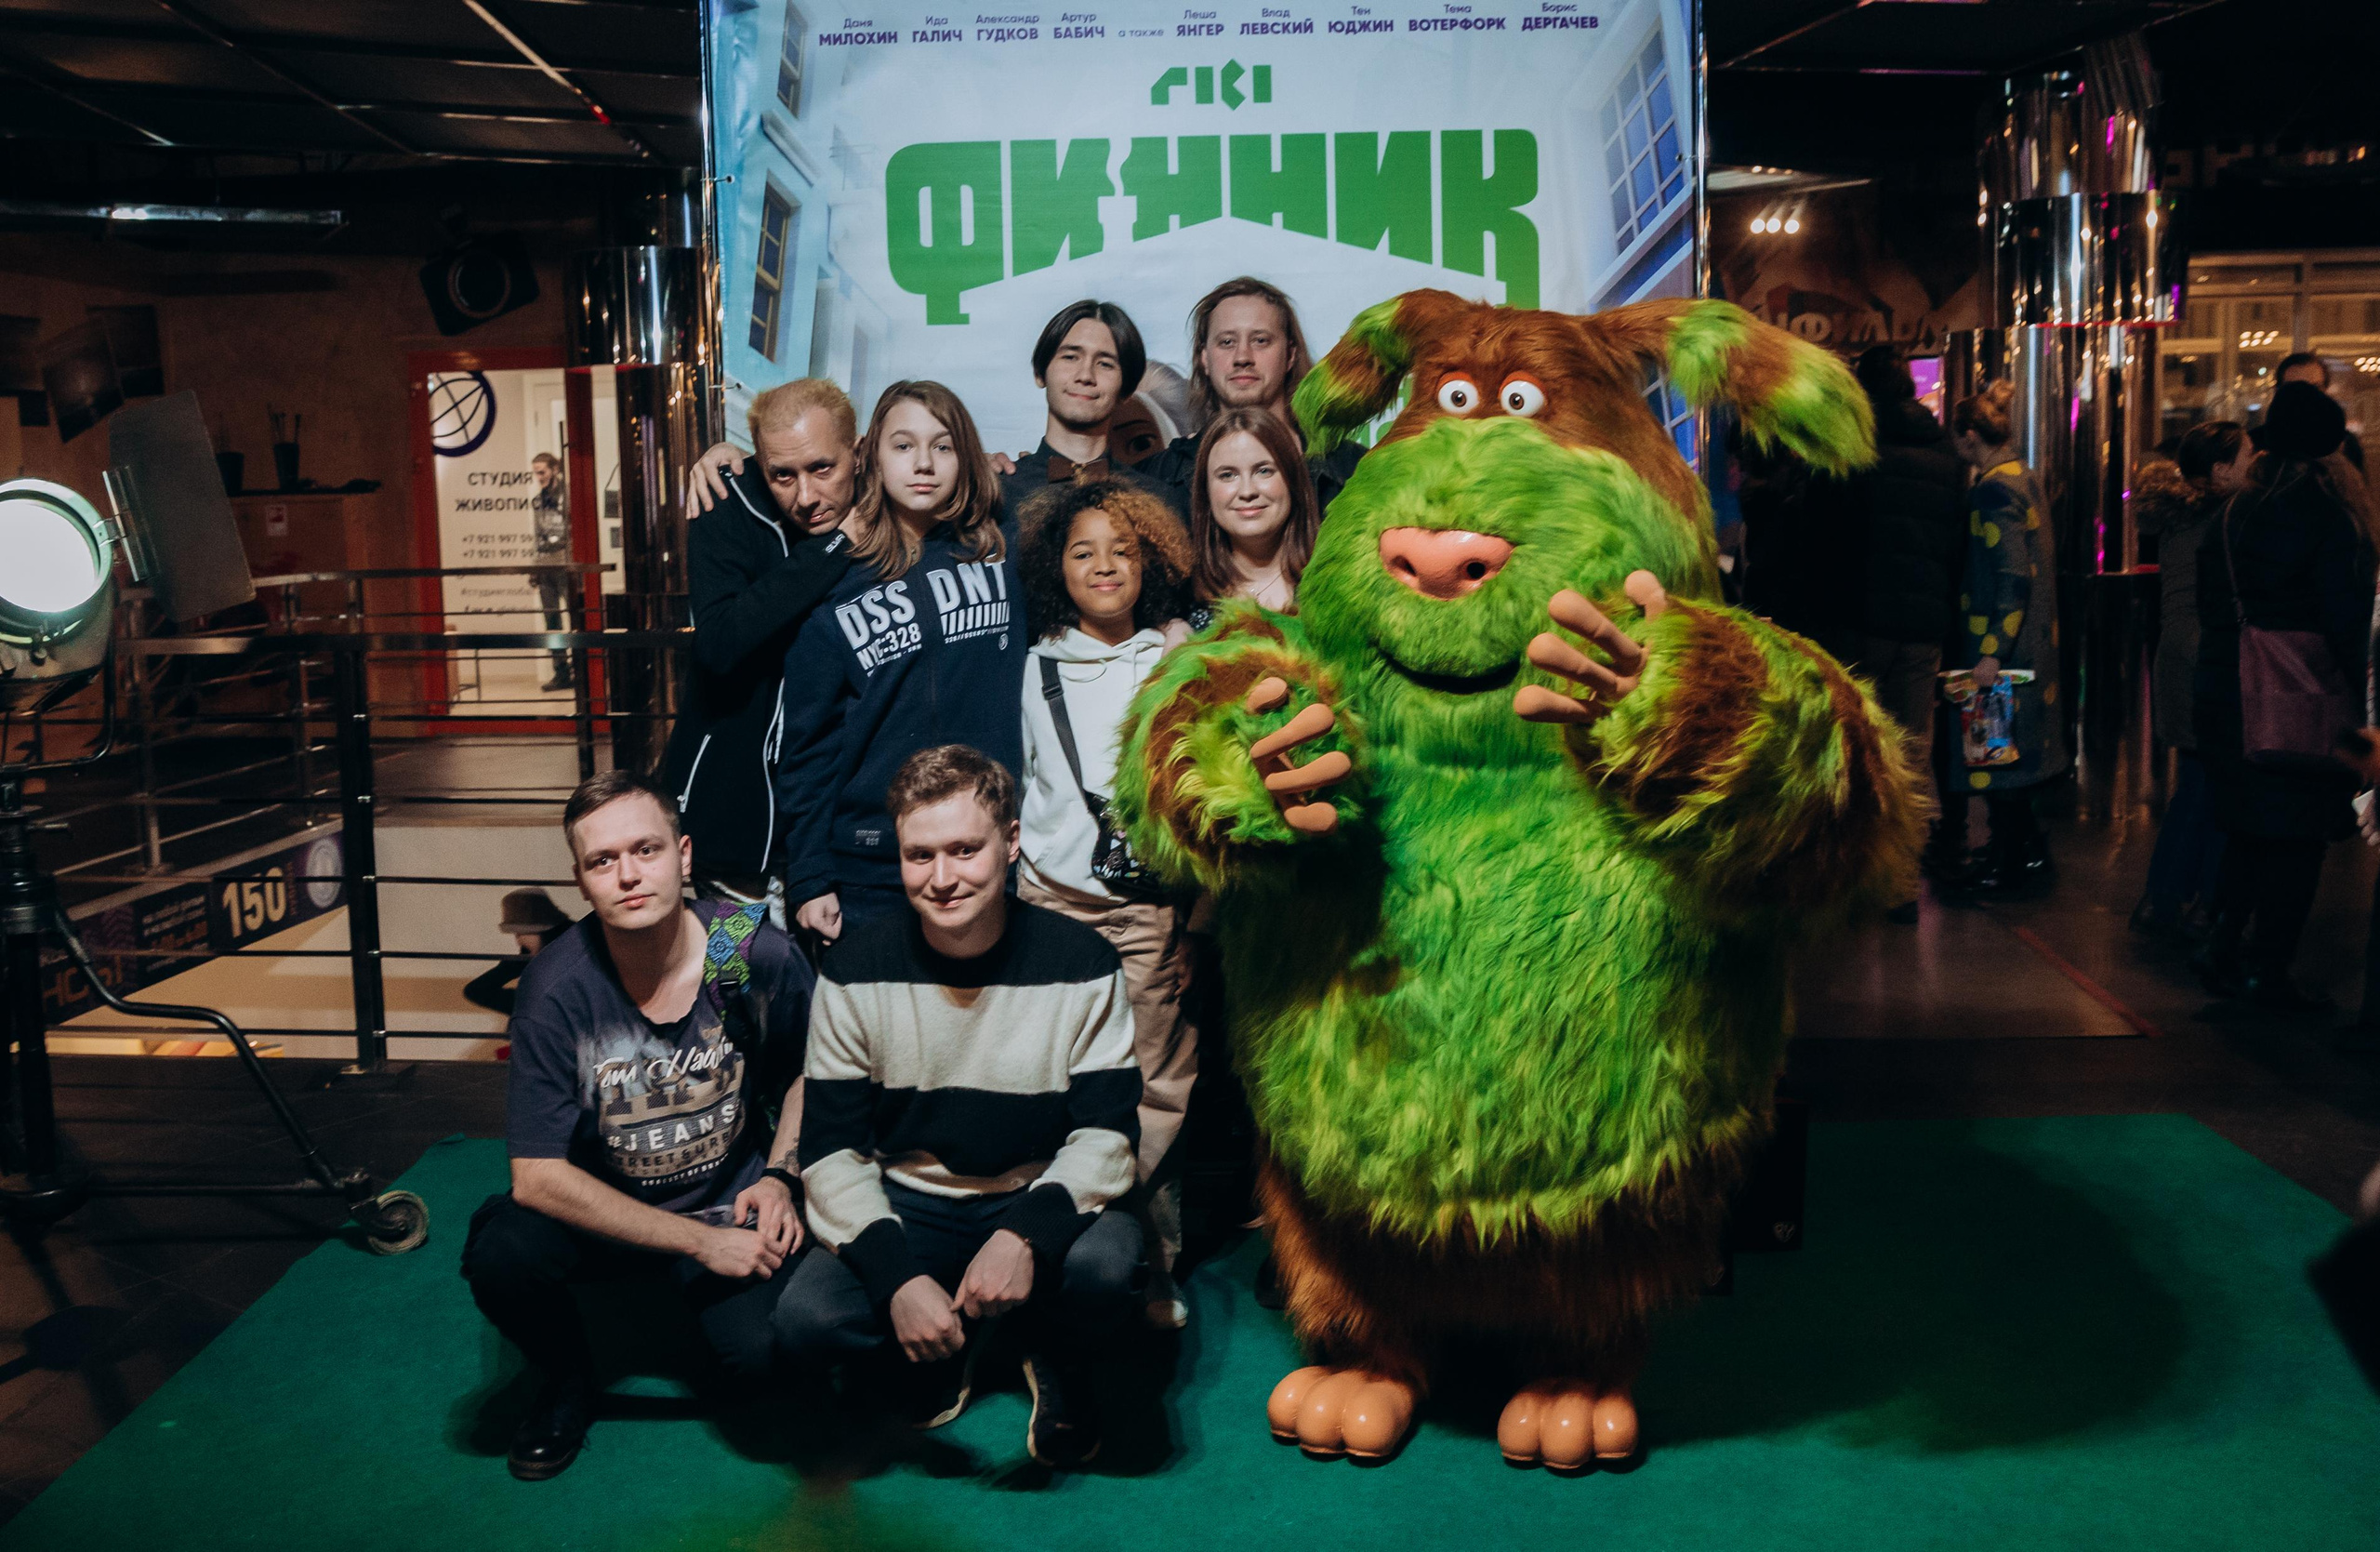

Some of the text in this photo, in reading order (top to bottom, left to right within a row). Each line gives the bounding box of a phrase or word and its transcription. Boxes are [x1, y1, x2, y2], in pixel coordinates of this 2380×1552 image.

[818, 31, 899, 46] МИЛОХИН
[912, 29, 963, 44] ГАЛИЧ
[976, 27, 1039, 43] ГУДКОВ
[1053, 25, 1105, 40] БАБИЧ
[1128, 28, 1164, 38] также
[1176, 23, 1225, 37] ЯНГЕР
[1239, 19, 1315, 36] ЛЕВСКИЙ
[1328, 19, 1395, 34] ЮДЖИН
[1408, 17, 1506, 33] ВОТЕРФОРК
[1521, 15, 1599, 32] ДЕРГАЧЕВ
[844, 19, 873, 30] Даня
[925, 16, 948, 27] Ида
[975, 14, 1040, 25] Александр
[1061, 12, 1097, 24] Артур
[1262, 8, 1290, 19] Влад
[1351, 6, 1371, 16] Тен
[1444, 4, 1473, 14] Тема
[1541, 3, 1579, 14] Борис
[885, 128, 1540, 326] ФИННИК
[468, 471, 534, 487] СТУДИЯ
[835, 552, 1007, 651] DSS DNT
[222, 866, 287, 938] 150
[624, 1104, 735, 1152] JEANS
